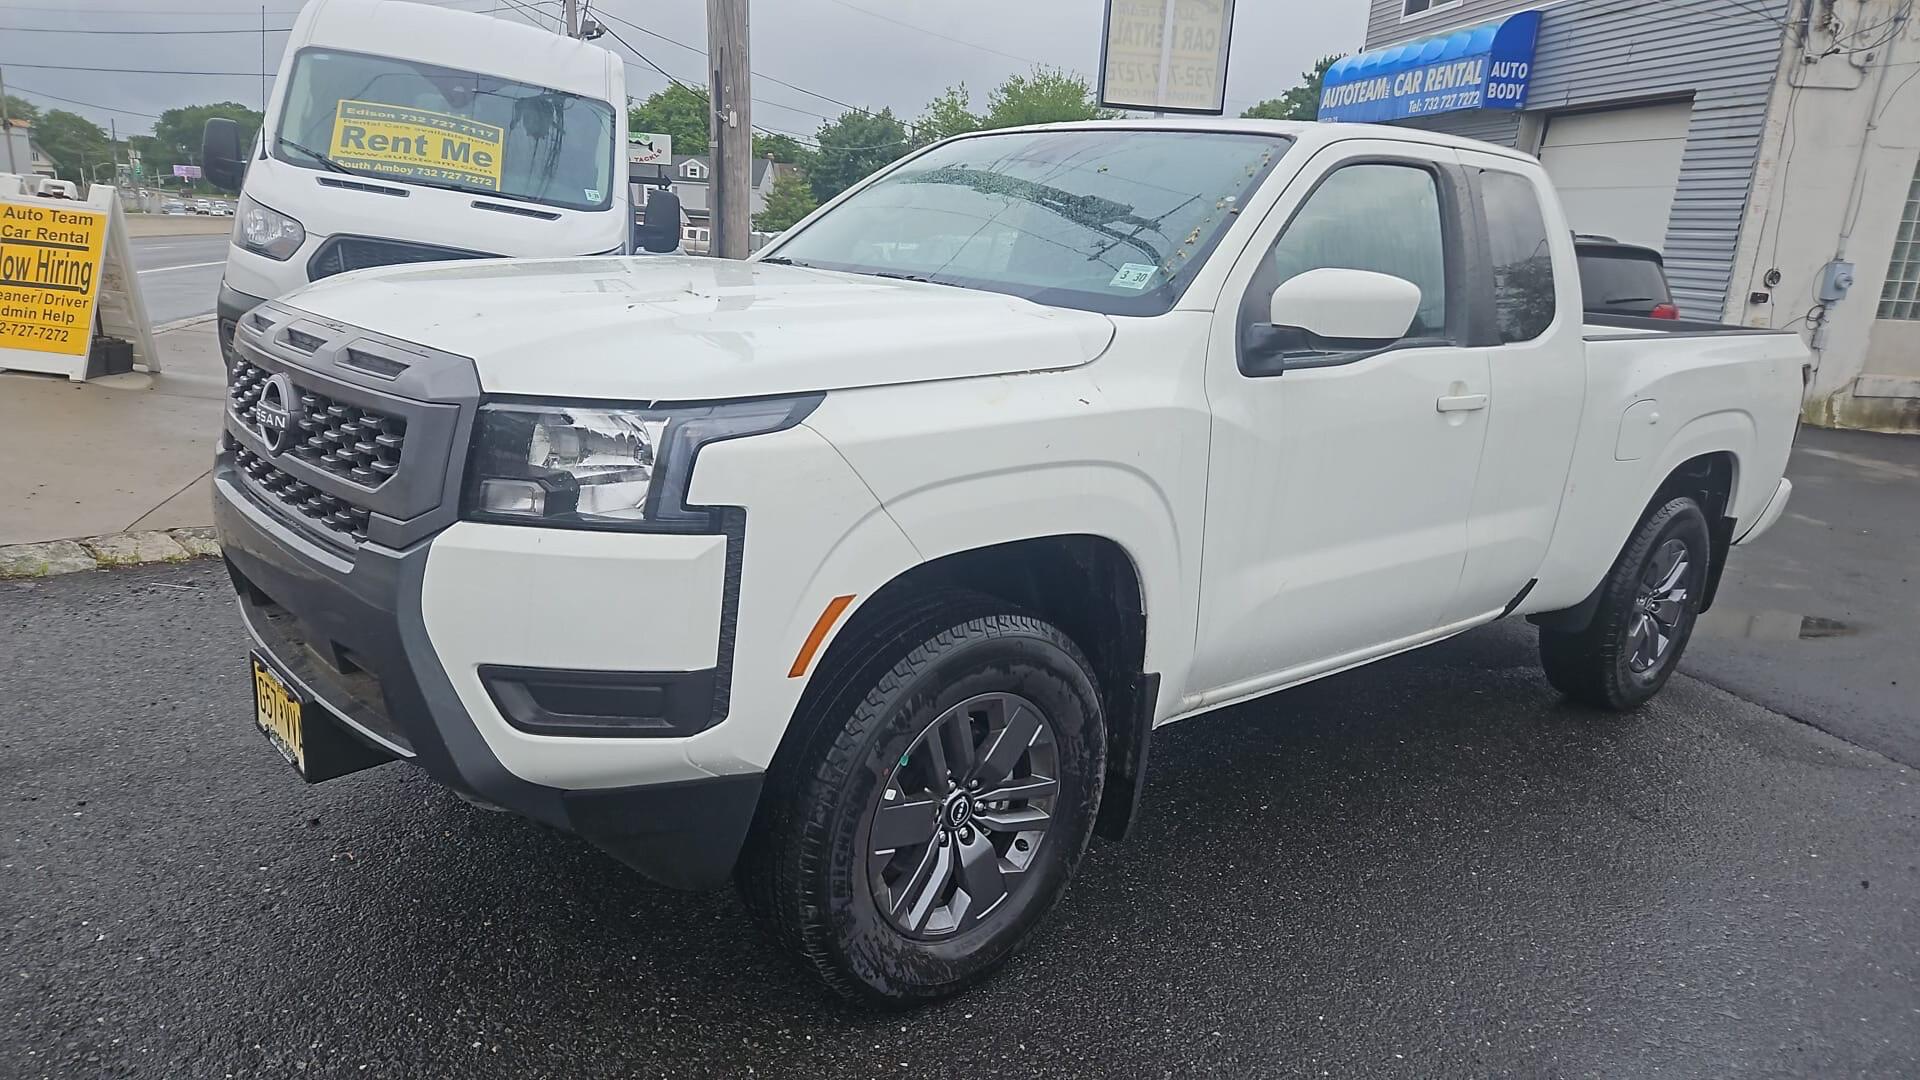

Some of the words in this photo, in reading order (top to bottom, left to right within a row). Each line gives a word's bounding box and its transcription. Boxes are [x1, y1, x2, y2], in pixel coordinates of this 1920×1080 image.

[1490, 62, 1528, 79] AUTO
[1320, 78, 1387, 109] AUTOTEAM
[1394, 71, 1423, 97] CAR
[1424, 60, 1482, 92] RENTAL
[1487, 82, 1525, 100] BODY
[1408, 100, 1421, 114] Tel:
[1423, 96, 1440, 111] 732
[1440, 93, 1458, 109] 727
[1457, 91, 1480, 107] 7272
[343, 119, 381, 127] Rental
[346, 107, 396, 119] Edison
[400, 113, 427, 123] 732
[430, 118, 457, 129] 727
[461, 124, 494, 138] 7117
[340, 125, 428, 158] Rent
[441, 138, 493, 168] Me
[340, 150, 494, 174] www.autoteam.com
[337, 160, 371, 171] South
[374, 163, 414, 176] Amboy
[417, 167, 438, 178] 732
[440, 170, 462, 181] 727
[464, 174, 493, 187] 7272
[3, 206, 43, 221] Auto
[50, 209, 94, 227] Team
[2, 224, 31, 239] Car
[36, 227, 90, 244] Rental
[0, 246, 31, 281] ow
[36, 249, 93, 295] Hiring
[1120, 270, 1130, 280] 3
[1132, 272, 1148, 282] 30
[42, 308, 75, 326] Help
[256, 407, 286, 429] SSAN
